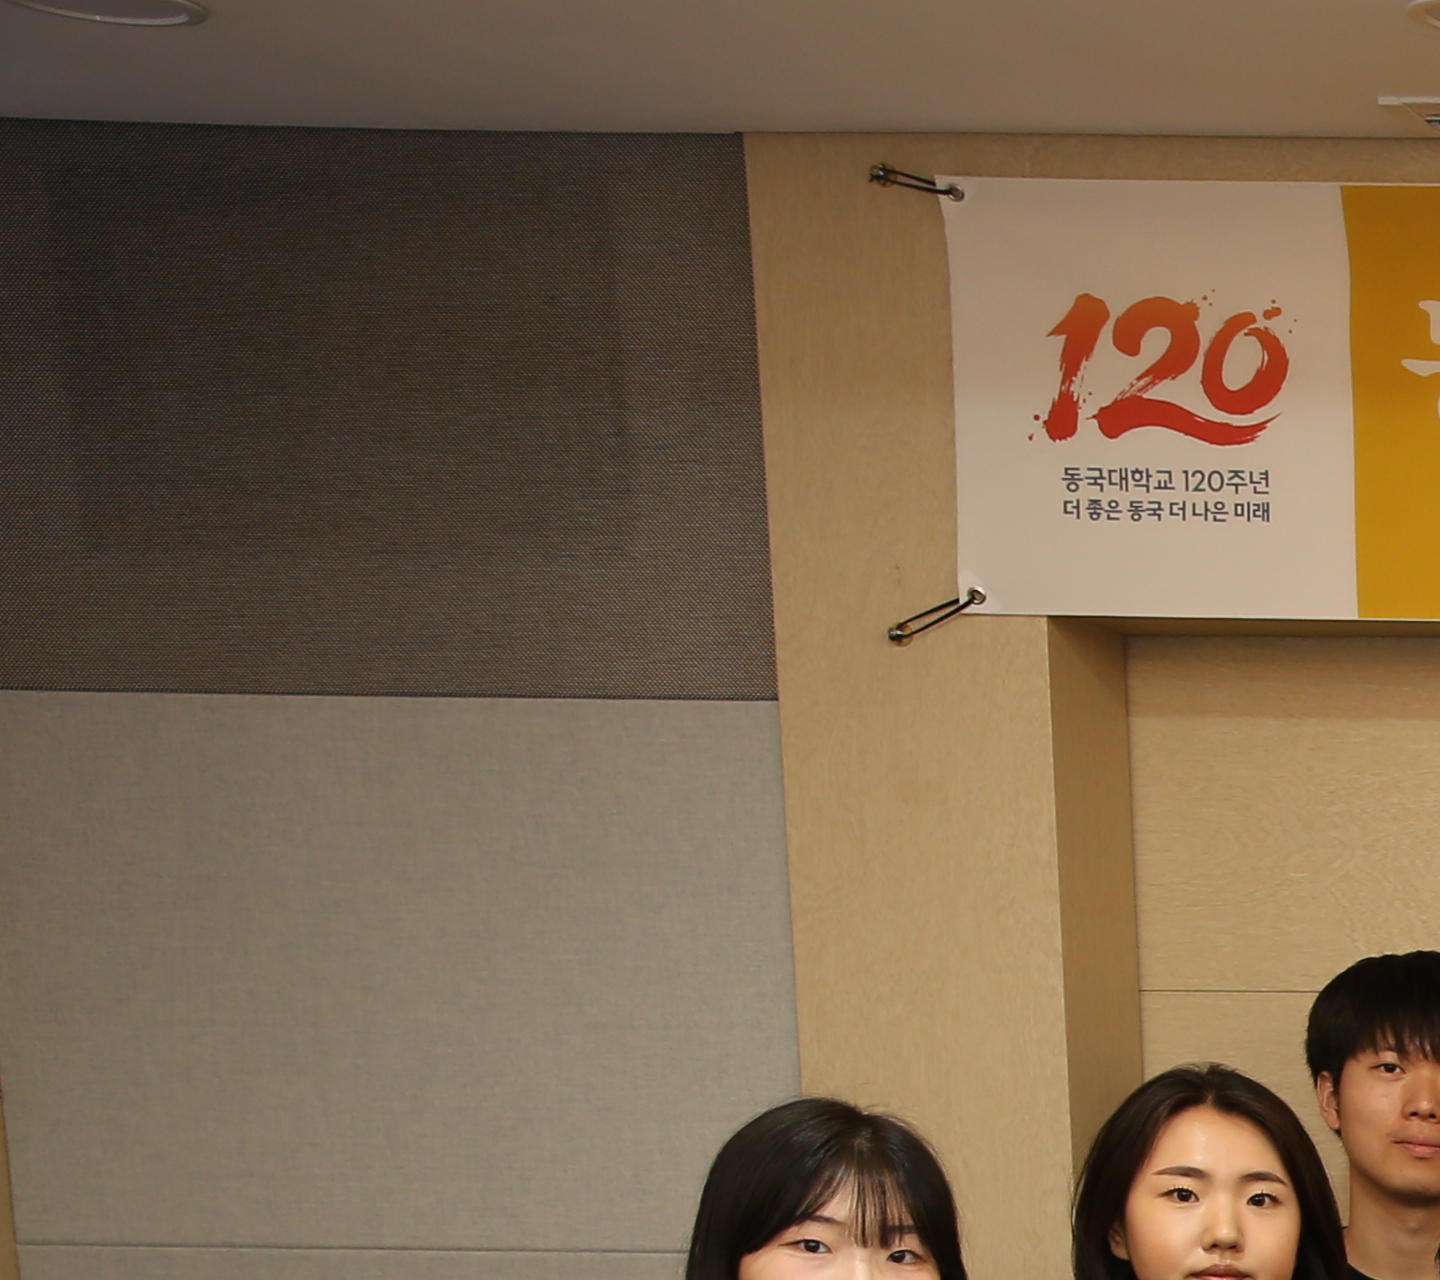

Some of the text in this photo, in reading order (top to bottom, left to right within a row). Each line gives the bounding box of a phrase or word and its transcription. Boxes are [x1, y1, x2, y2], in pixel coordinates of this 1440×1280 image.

[1042, 293, 1290, 446] 120
[1061, 467, 1269, 495] 동국대학교 120주년
[1063, 498, 1270, 523] 더 좋은 동국 더 나은 미래
